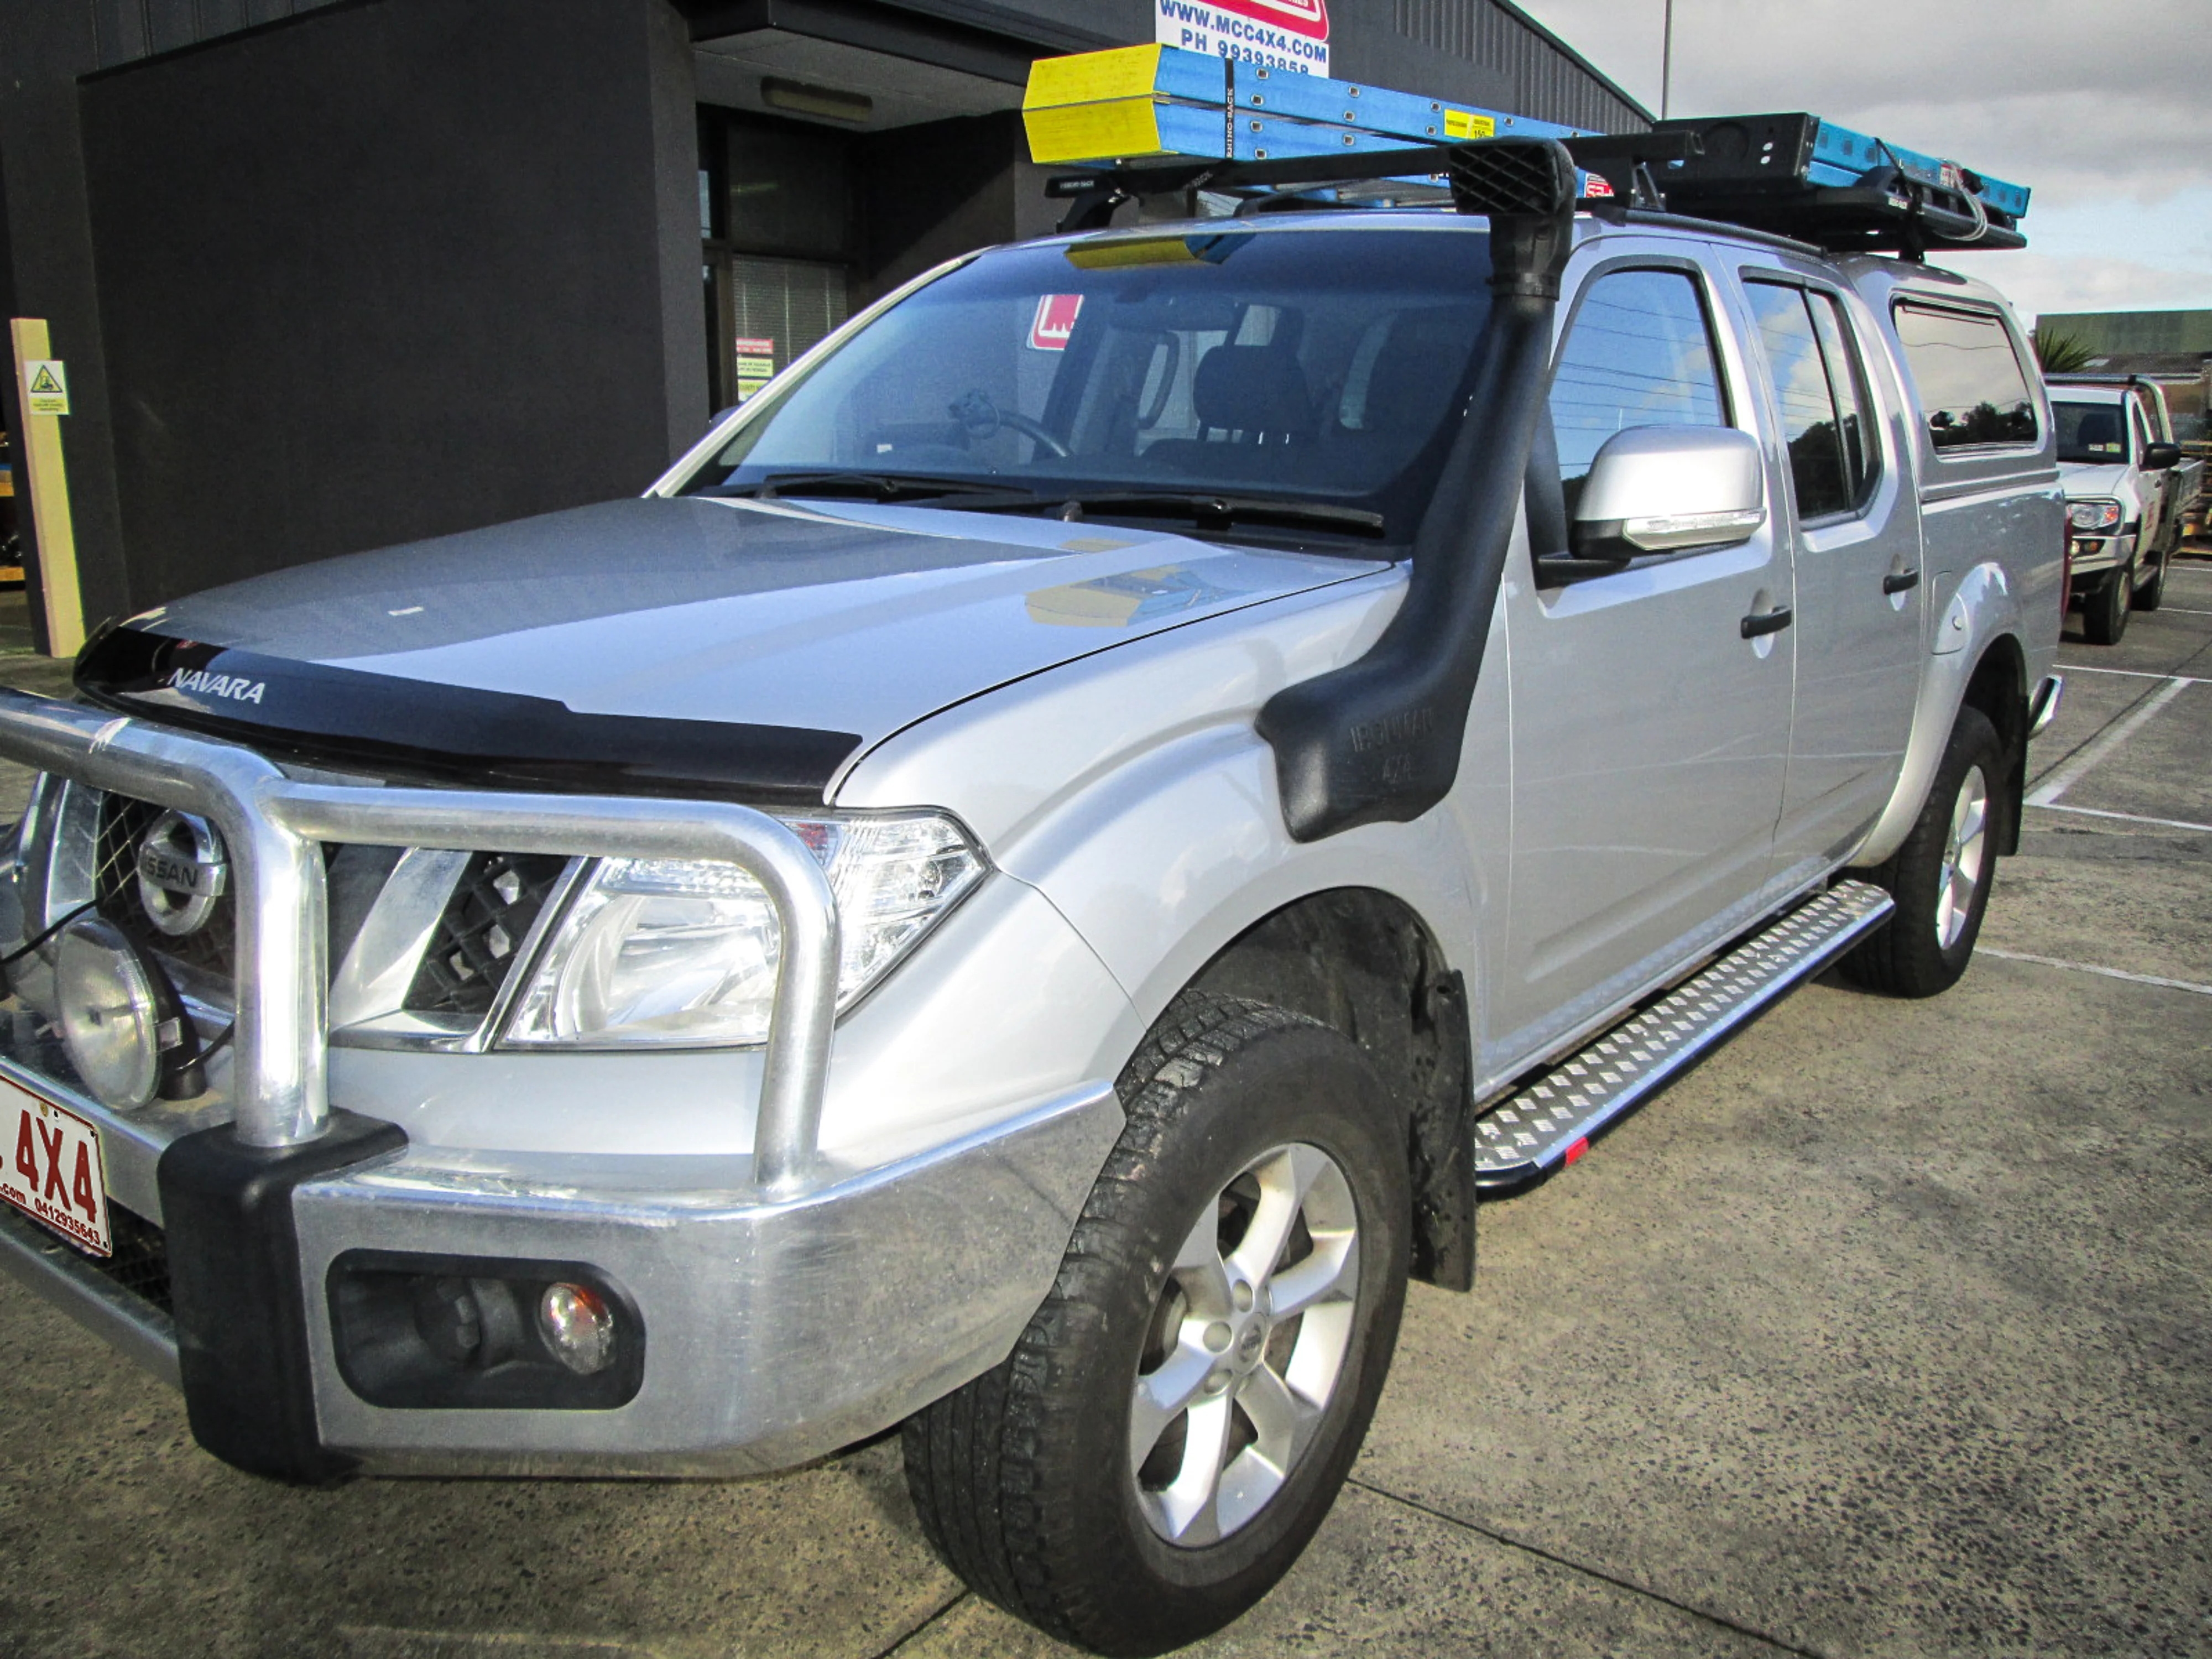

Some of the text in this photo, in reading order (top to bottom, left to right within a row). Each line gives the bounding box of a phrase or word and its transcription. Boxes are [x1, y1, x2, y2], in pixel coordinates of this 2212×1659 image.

[1160, 0, 1327, 63] WWW.MCC4X4.COM
[1181, 28, 1207, 51] PH
[167, 667, 265, 704] NAVARA
[15, 1108, 97, 1224] 4X4
